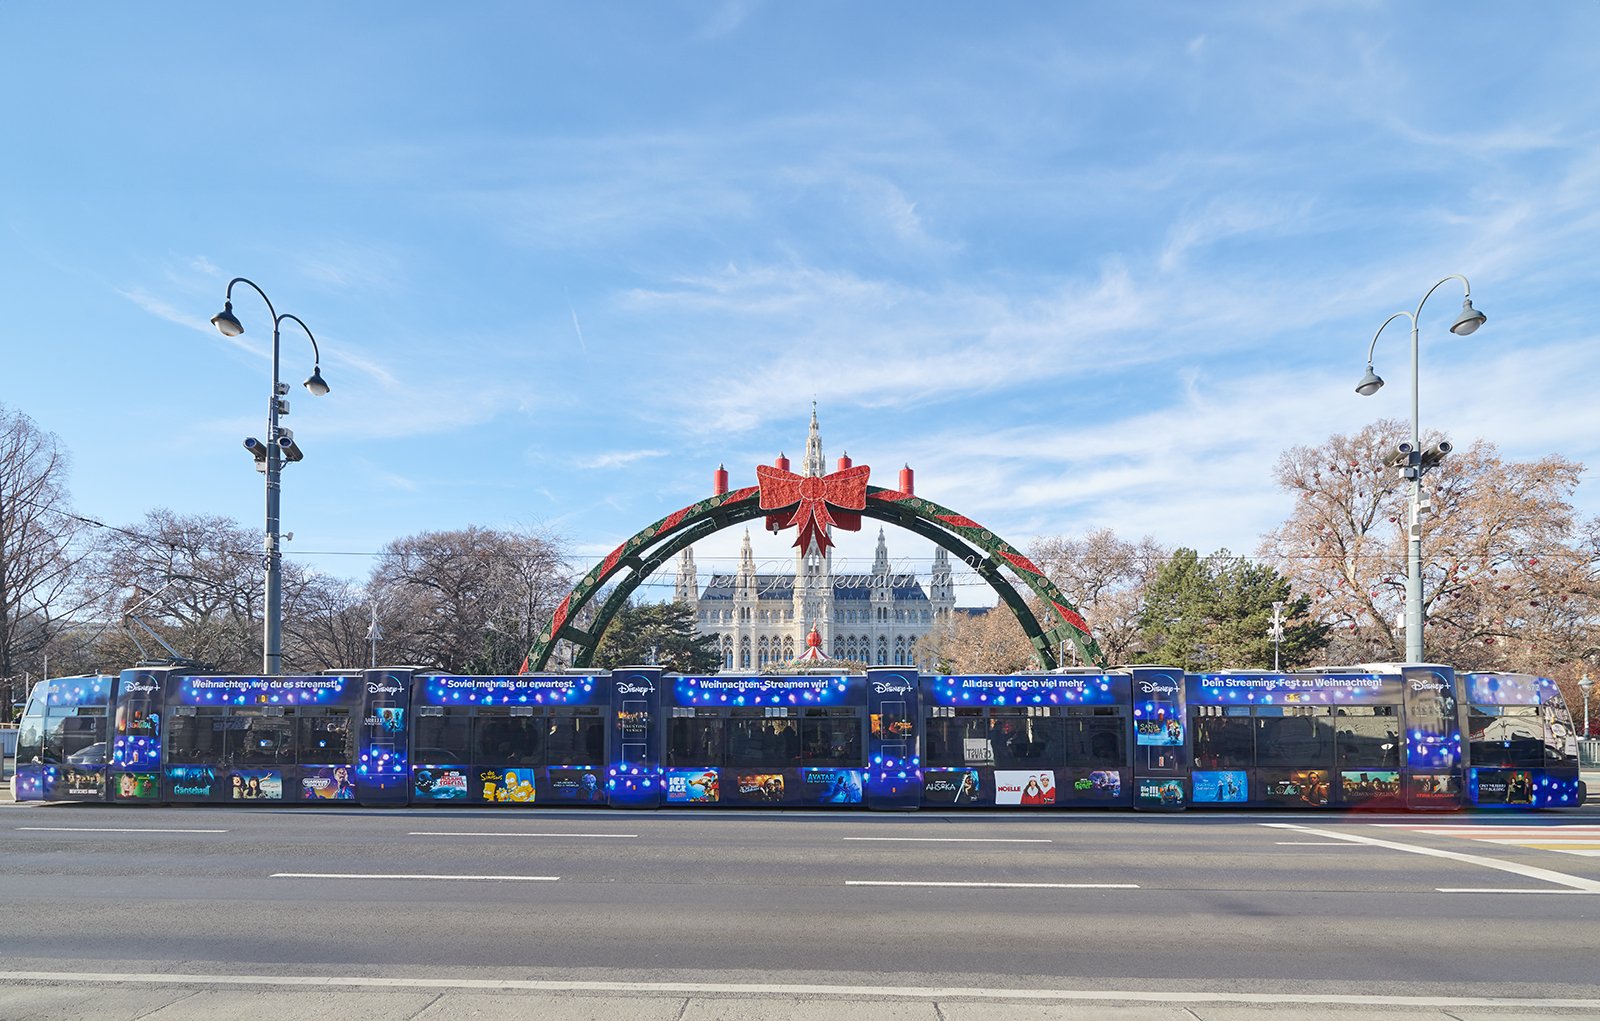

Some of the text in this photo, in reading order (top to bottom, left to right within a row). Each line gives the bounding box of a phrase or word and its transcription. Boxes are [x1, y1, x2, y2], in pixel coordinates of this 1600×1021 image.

[124, 681, 160, 694] Disney+
[192, 680, 252, 689] Weihnachten,
[252, 680, 268, 688] wie
[270, 680, 281, 688] du
[295, 680, 337, 688] streamst!
[447, 680, 575, 688] Soviel mehr als du erwartest.
[700, 680, 828, 689] Weihnachten: Streamen wir!
[872, 681, 913, 695] Disney+
[962, 679, 1086, 688] All das und noch viel mehr.
[1139, 681, 1180, 696] Disney+
[1202, 678, 1382, 688] Dein Streaming-Fest zu Weihnachten!
[1408, 679, 1451, 693] Disney+
[366, 682, 404, 696] Disney+
[616, 682, 655, 696] Disney+
[926, 783, 956, 791] AHSOKA
